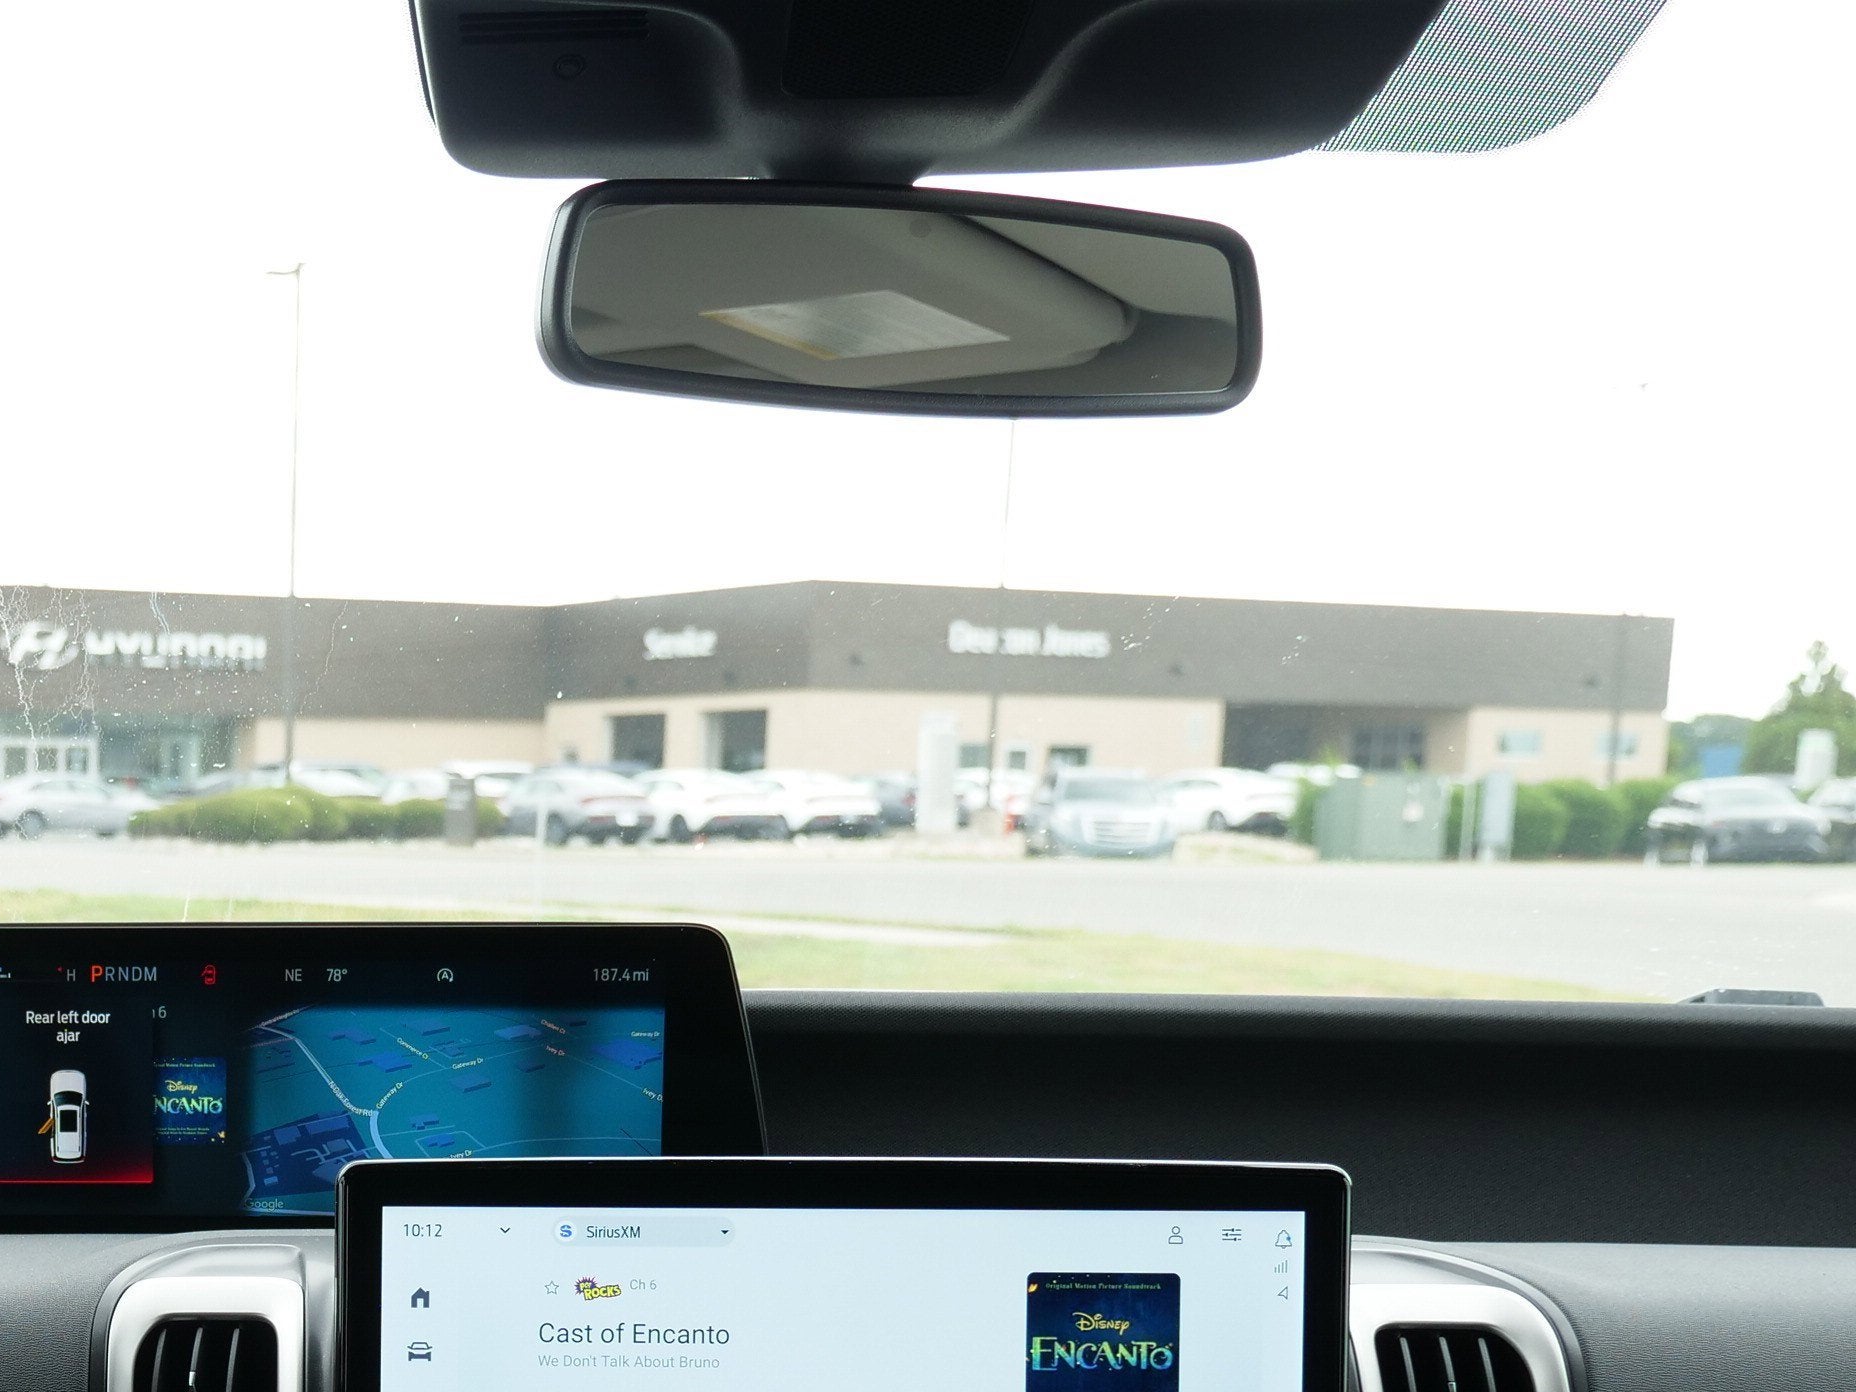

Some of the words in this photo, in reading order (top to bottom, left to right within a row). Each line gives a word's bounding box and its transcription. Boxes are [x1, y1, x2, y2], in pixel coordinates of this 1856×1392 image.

[66, 968, 76, 982] H
[284, 968, 303, 982] NE
[593, 968, 631, 982] 187.4
[632, 968, 650, 982] mi
[25, 1010, 55, 1025] Rear
[56, 1010, 79, 1025] left
[81, 1010, 111, 1025] door
[56, 1028, 81, 1045] ajar
[154, 1096, 223, 1115] NCANTO
[243, 1197, 284, 1211] Google
[402, 1223, 443, 1237] 10:12
[586, 1225, 641, 1239] SiriusXM
[629, 1278, 646, 1290] Ch
[649, 1279, 657, 1290] 6
[584, 1285, 622, 1301] ROCKS
[539, 1322, 593, 1344] Cast
[600, 1322, 626, 1344] of
[632, 1323, 730, 1345] Encanto
[1031, 1336, 1174, 1371] ENCANTO
[538, 1355, 559, 1367] We
[563, 1355, 597, 1367] Don't
[601, 1355, 630, 1367] Talk
[633, 1356, 675, 1368] About
[679, 1356, 720, 1369] Bruno
